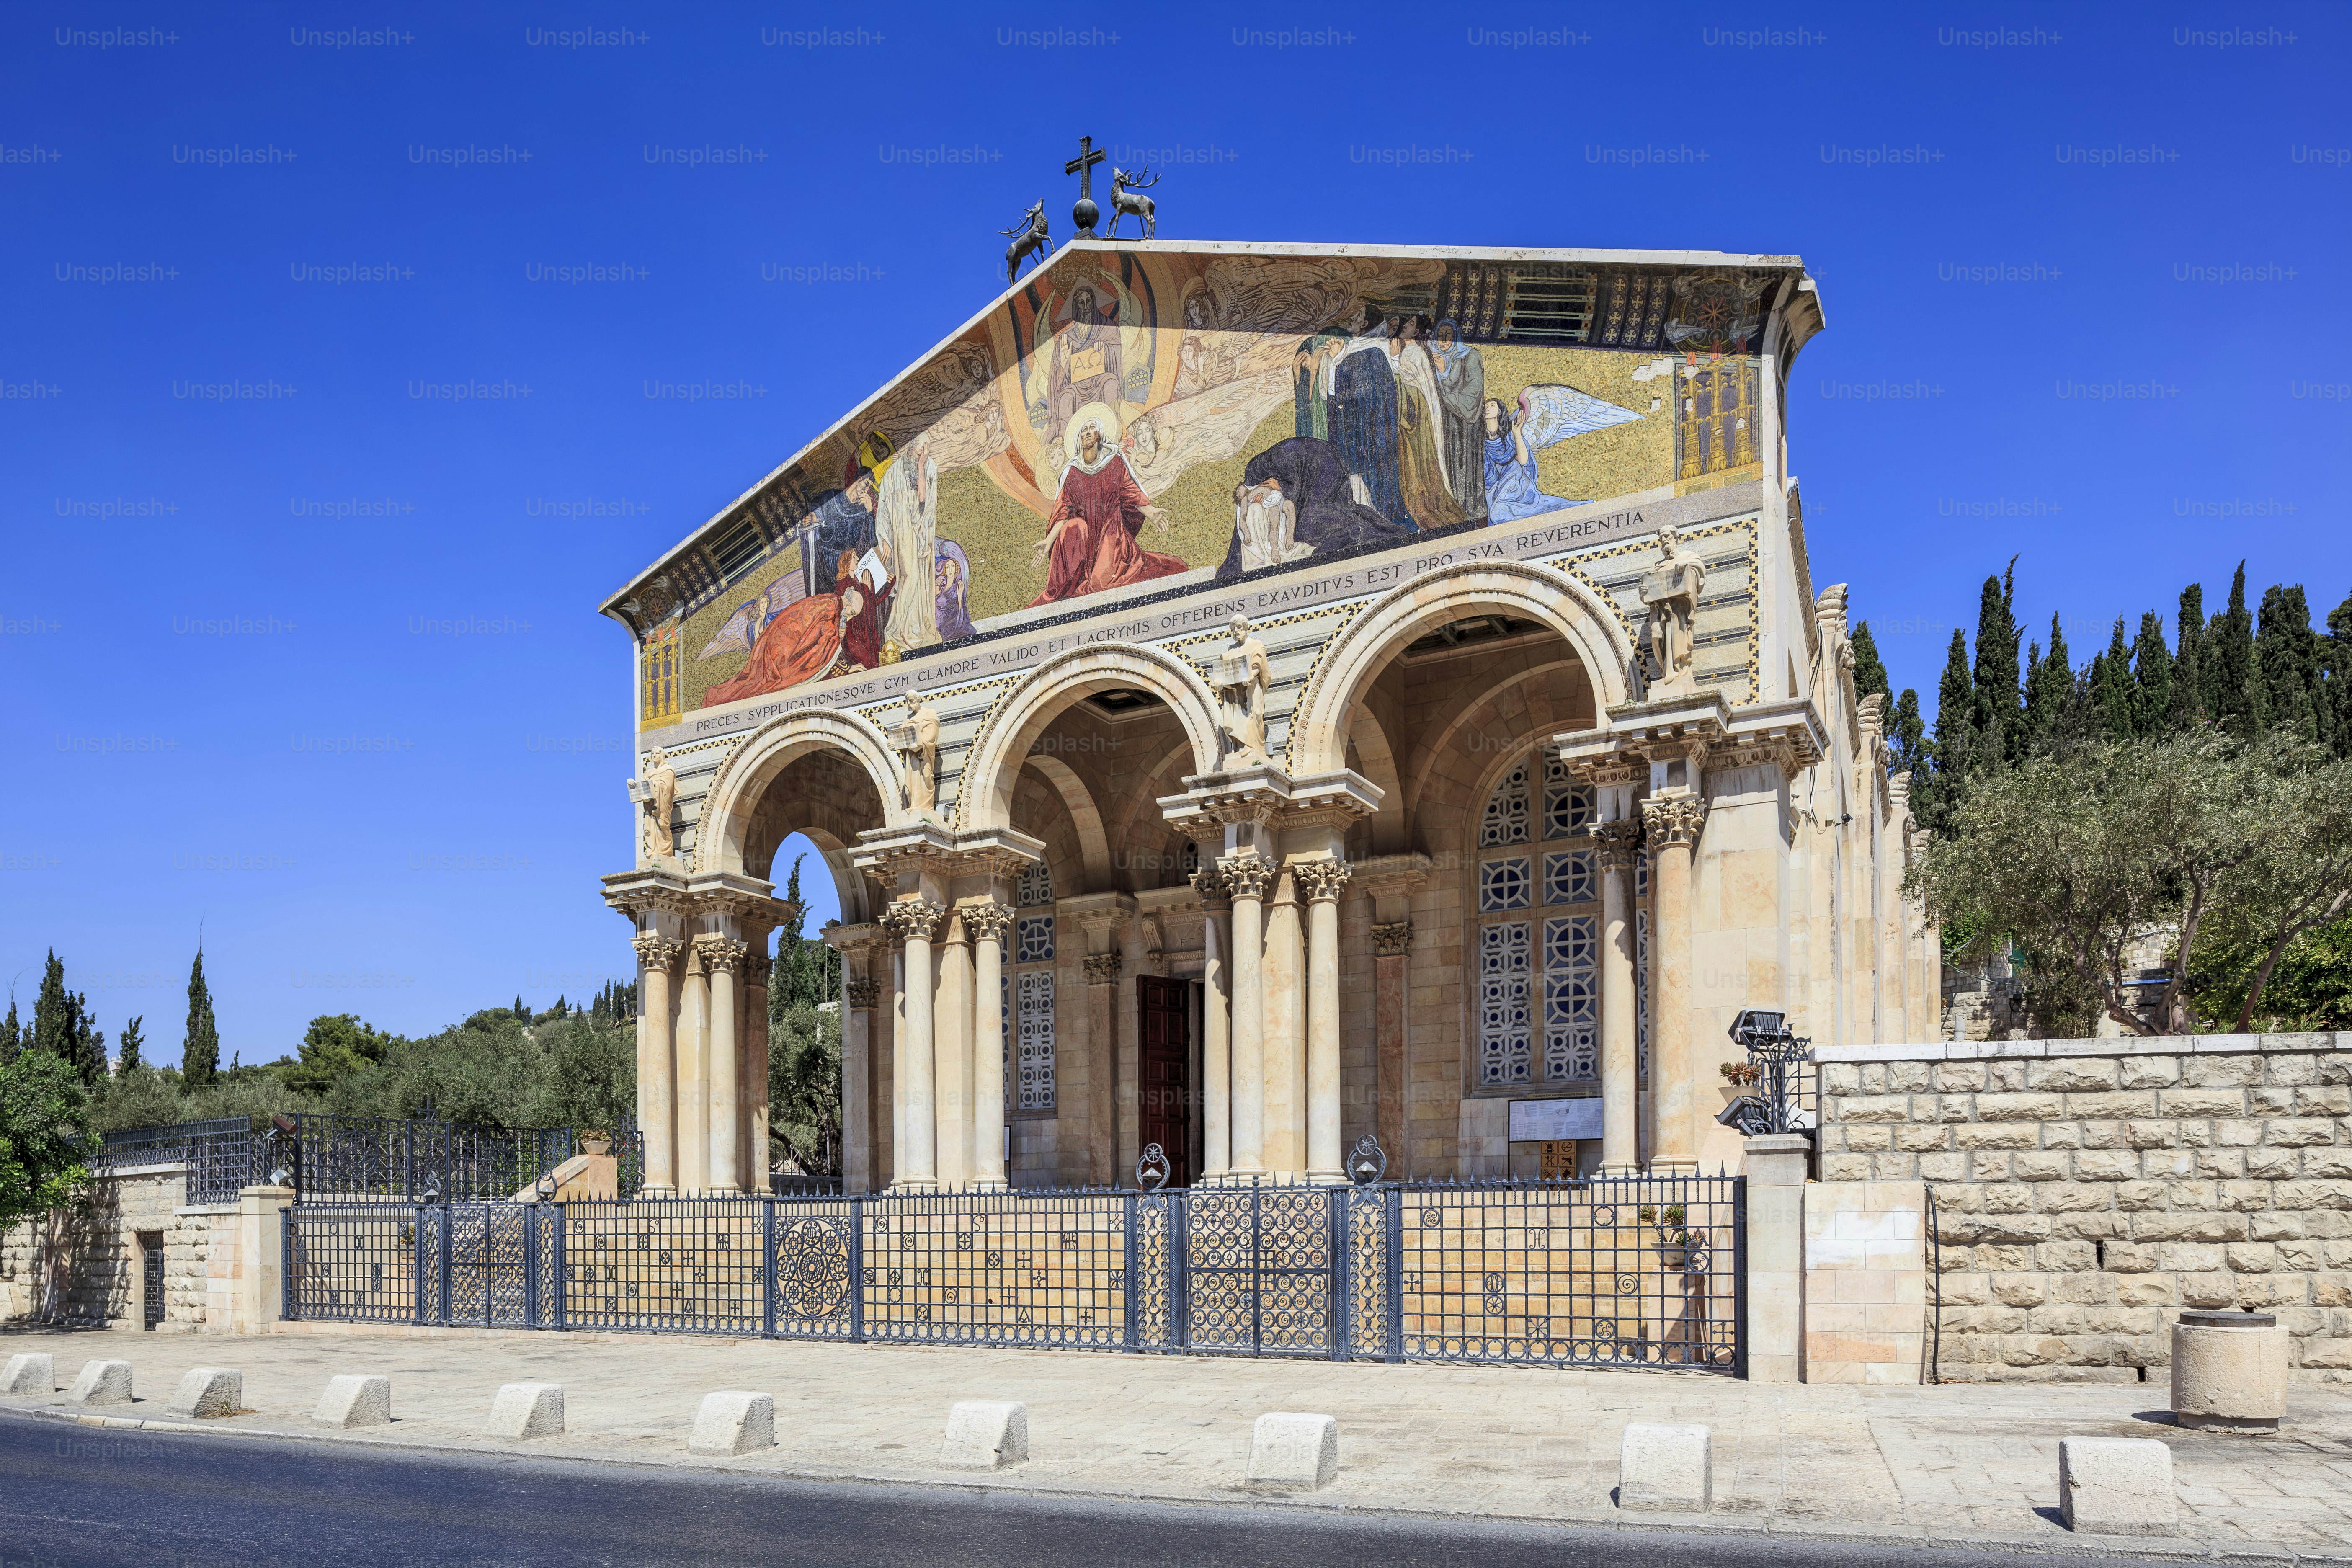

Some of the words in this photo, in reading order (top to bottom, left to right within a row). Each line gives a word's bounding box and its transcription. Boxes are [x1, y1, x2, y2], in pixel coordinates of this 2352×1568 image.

[855, 552, 875, 576] IGNORATIO
[696, 713, 740, 732] PRECES
[748, 682, 875, 720] SVPPLICATIONESQVE
[884, 674, 909, 689] CVM
[918, 658, 979, 681] CLAMORE
[990, 645, 1039, 664] VALIDO
[1049, 638, 1067, 653] ET
[1078, 621, 1150, 646] LACRYMIS
[1161, 599, 1245, 628] OFFERENS
[1258, 575, 1354, 607] EXAVDITVS
[1367, 565, 1402, 584] EST
[1416, 554, 1452, 573] PRO
[1468, 543, 1504, 560] SVA
[1516, 511, 1644, 551] REVERENTIA
[1181, 938, 1194, 947] ET
